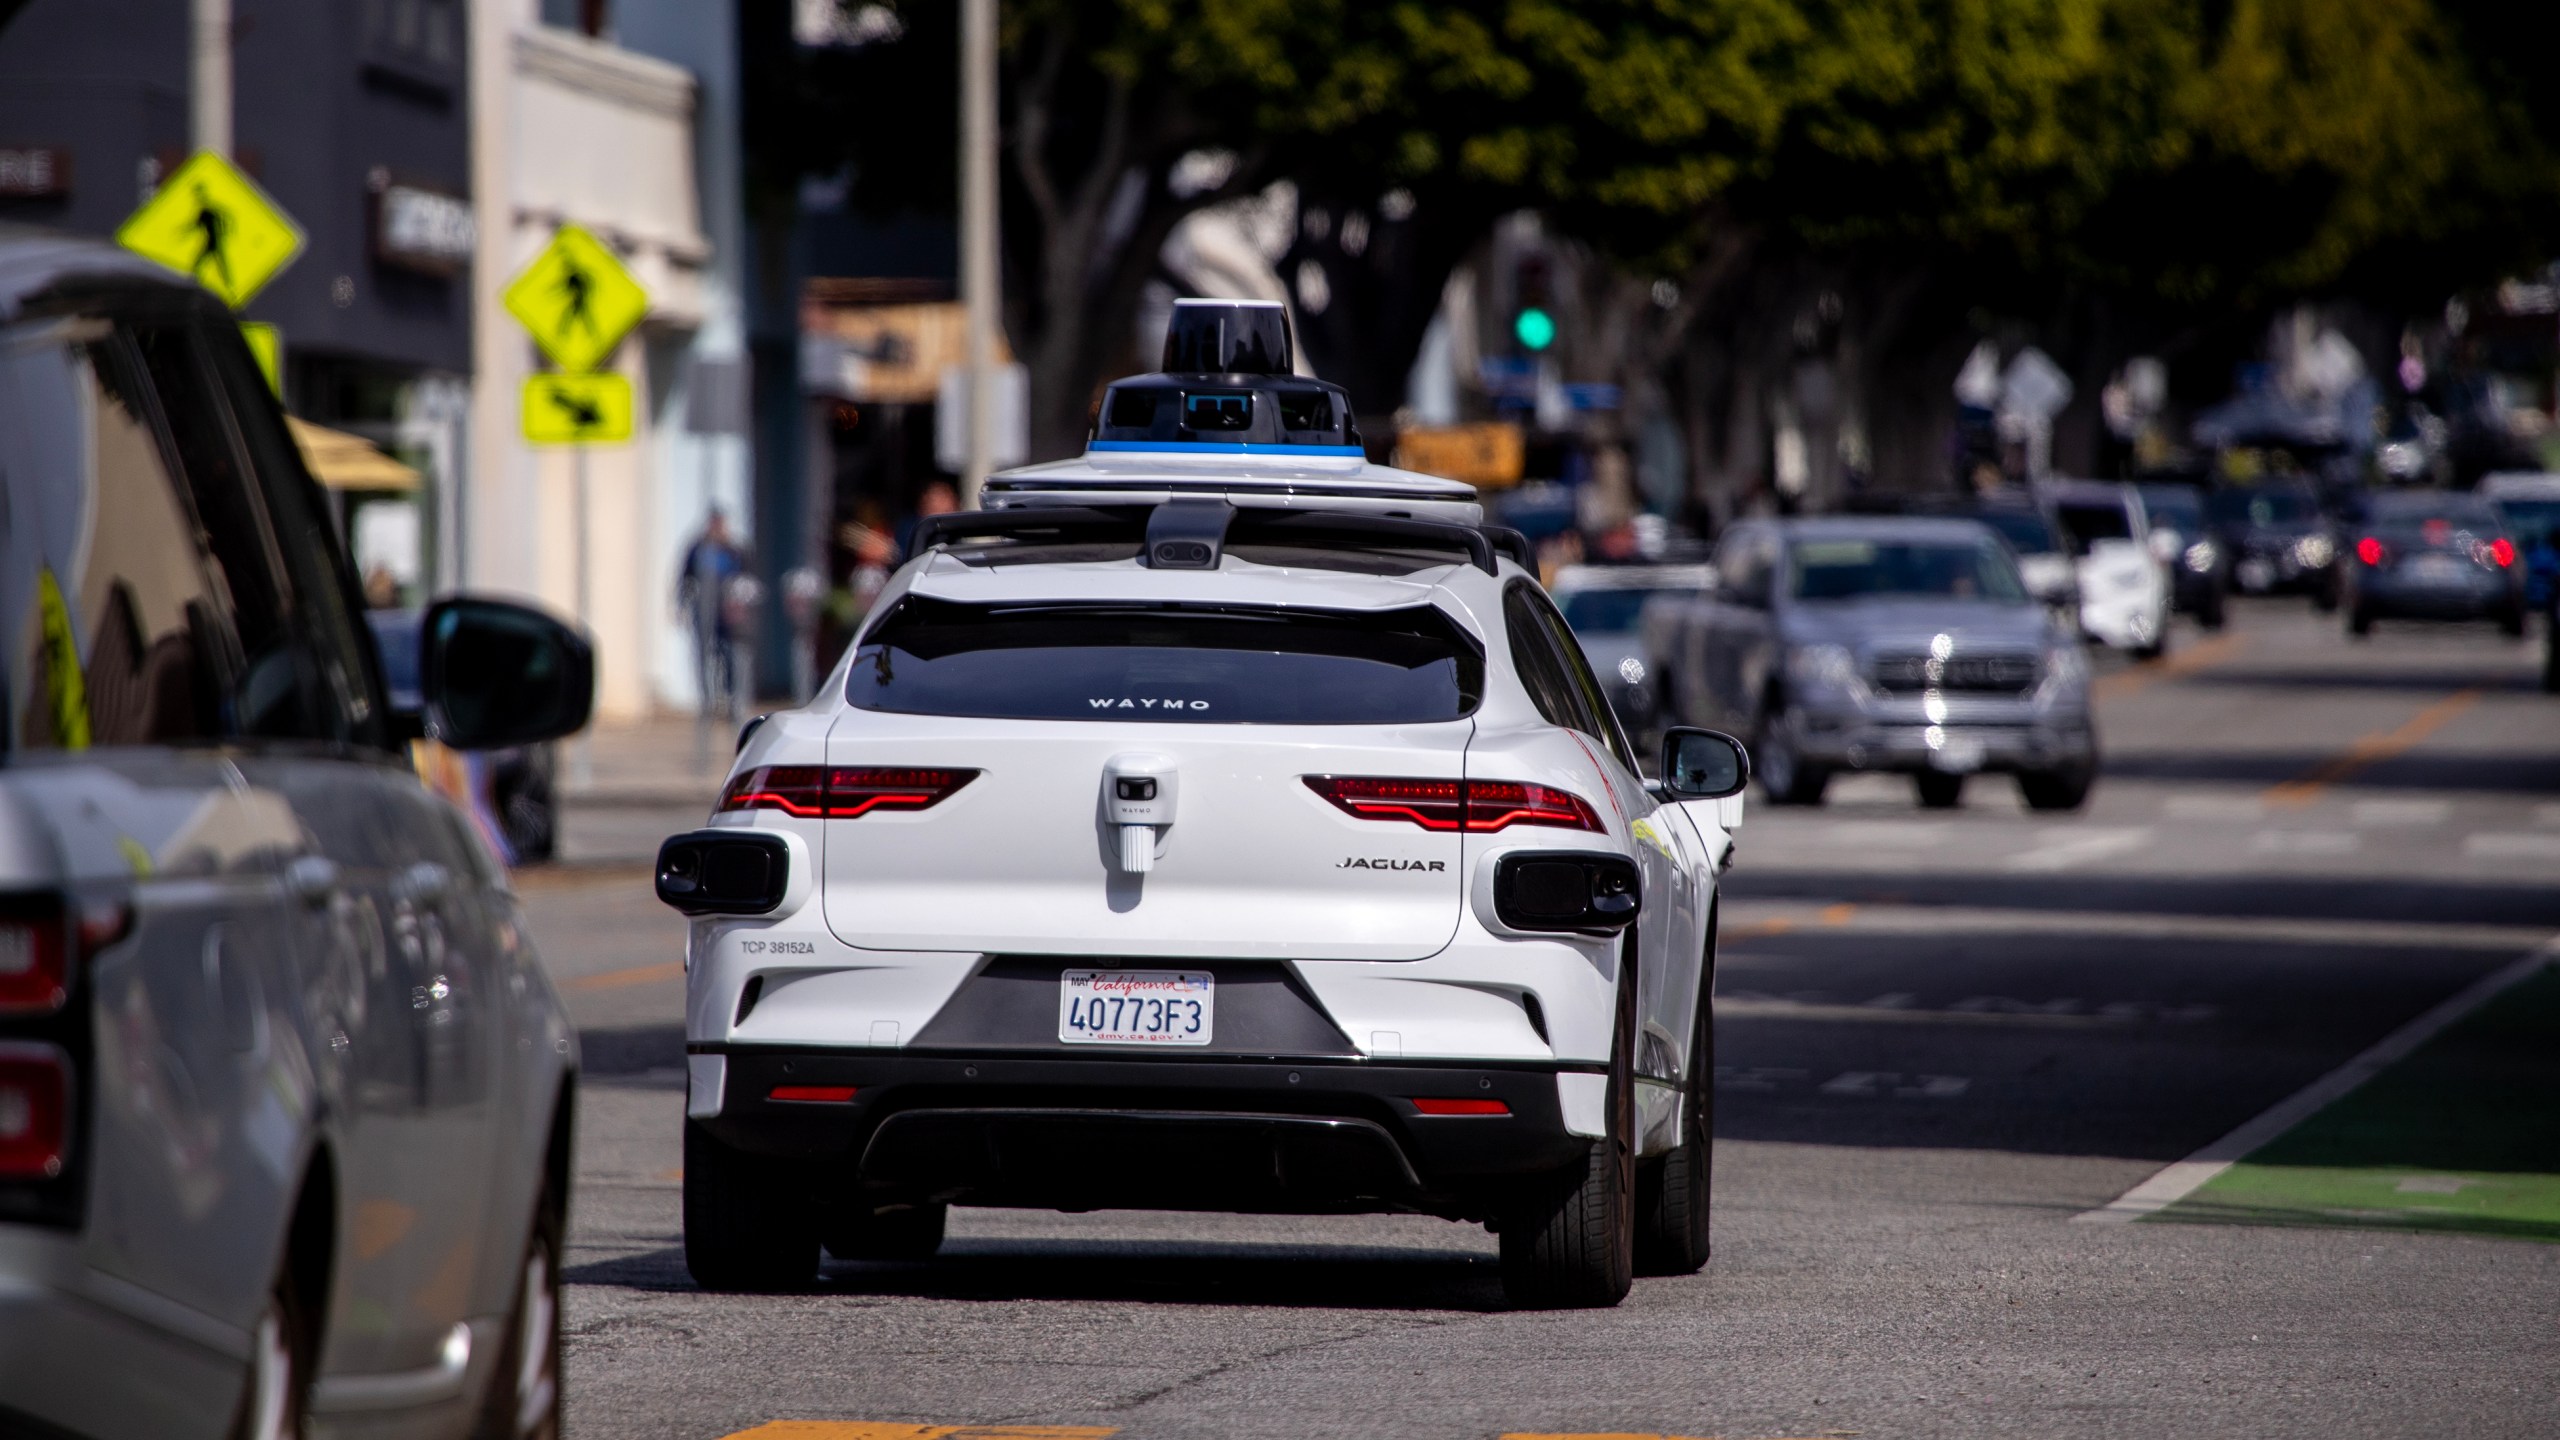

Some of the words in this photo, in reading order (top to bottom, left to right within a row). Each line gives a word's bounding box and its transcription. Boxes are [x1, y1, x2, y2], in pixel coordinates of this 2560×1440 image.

[1088, 698, 1210, 710] WAYMO
[1335, 857, 1446, 872] JAGUAR
[741, 941, 766, 953] TCP
[769, 941, 815, 953] 38152A
[1071, 977, 1090, 987] MAY
[1092, 974, 1176, 996] California
[1069, 996, 1202, 1033] 40773F3
[1097, 1033, 1174, 1041] dmv.ca.gov
